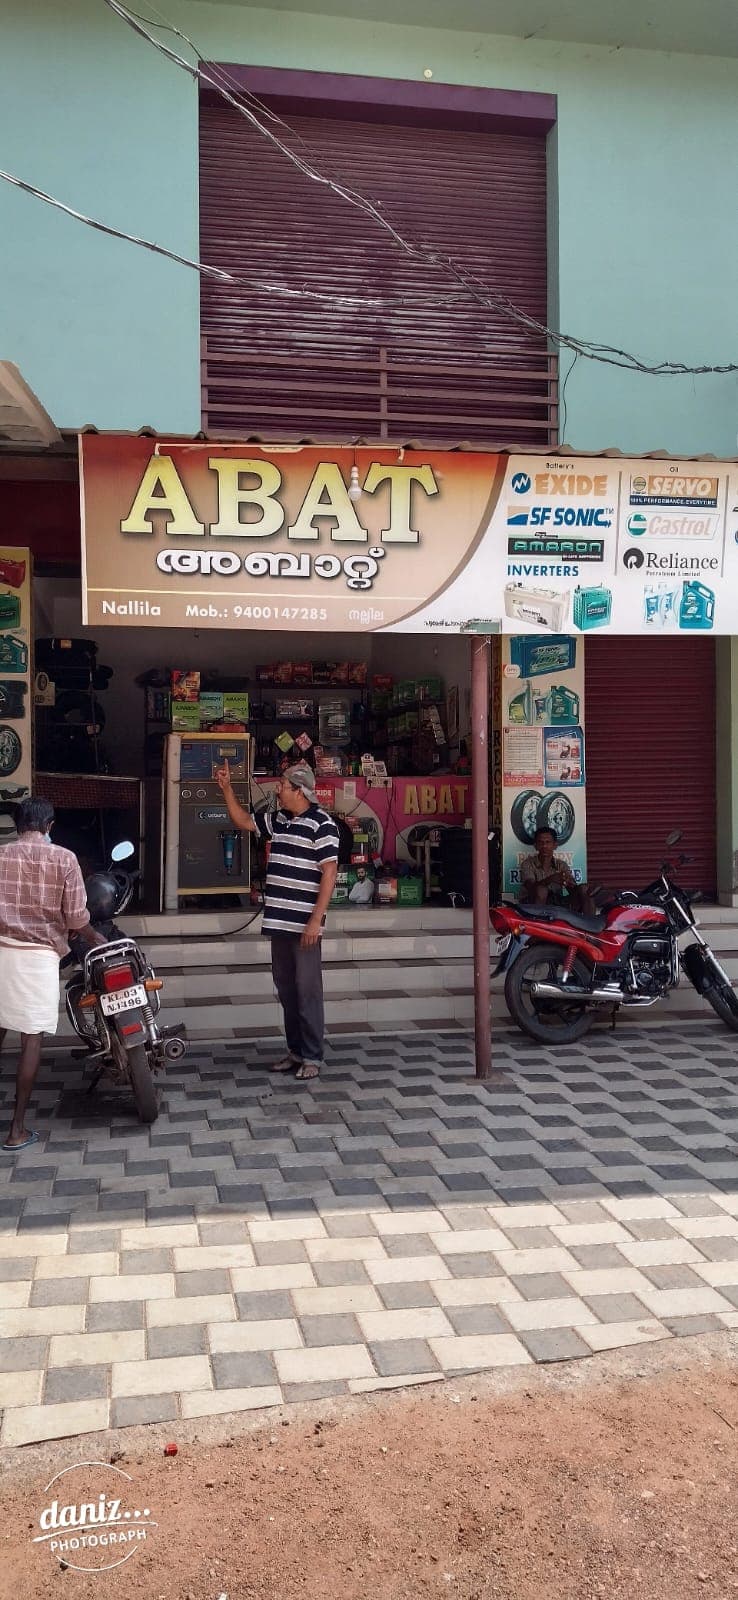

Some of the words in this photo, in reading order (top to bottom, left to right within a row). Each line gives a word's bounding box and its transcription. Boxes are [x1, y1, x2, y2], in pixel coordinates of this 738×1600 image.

[534, 473, 608, 496] EXIDE
[651, 477, 712, 496] SERVO
[120, 455, 438, 543] ABAT
[530, 507, 552, 525] SF
[648, 516, 712, 536] Castrol
[513, 541, 602, 552] AMARON
[645, 552, 719, 570] Reliance
[507, 564, 579, 577] INVERTERS
[102, 600, 161, 616] Nallila
[233, 605, 328, 621] 9400147285
[313, 789, 332, 797] XIDE
[404, 784, 468, 815] ABAT
